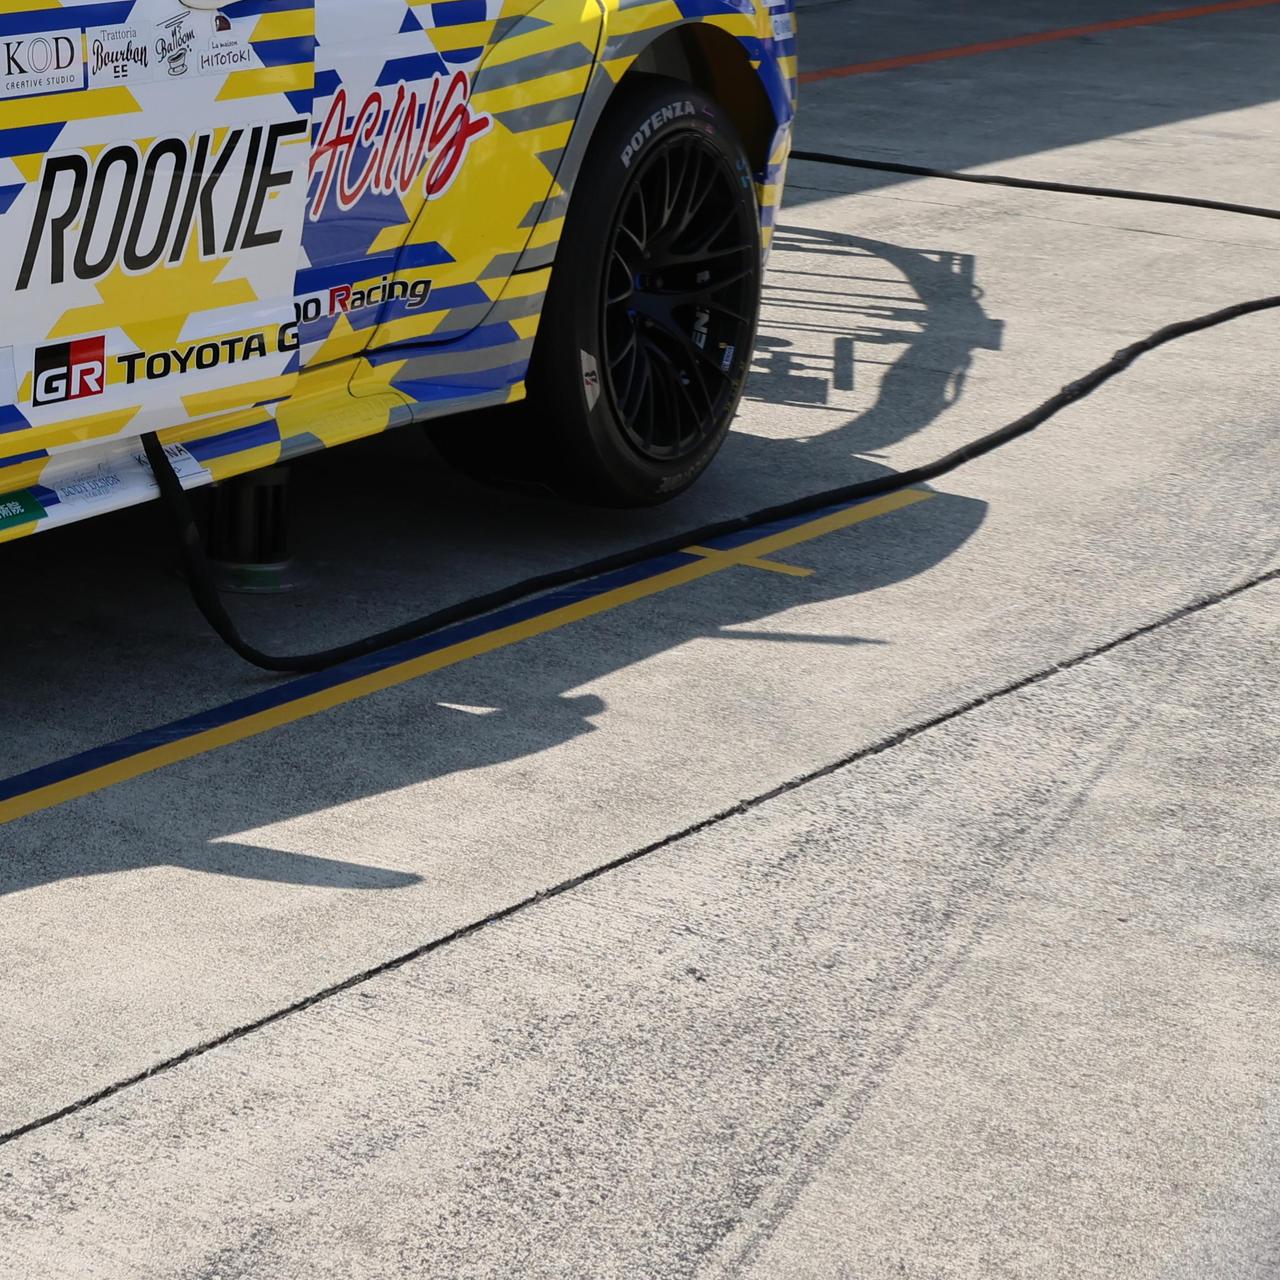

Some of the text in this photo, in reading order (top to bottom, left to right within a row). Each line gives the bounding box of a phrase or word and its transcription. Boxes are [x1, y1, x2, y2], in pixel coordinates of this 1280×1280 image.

[100, 27, 138, 42] Trattoria
[2, 35, 75, 77] KOD
[92, 38, 149, 76] Bourbon
[200, 48, 252, 70] HITOTOKI
[5, 74, 76, 91] CREATIVE STUDIO
[619, 99, 697, 170] POTENZA
[14, 68, 492, 293] ROOKIE ACING
[36, 275, 432, 403] GR TOYOTA Racing
